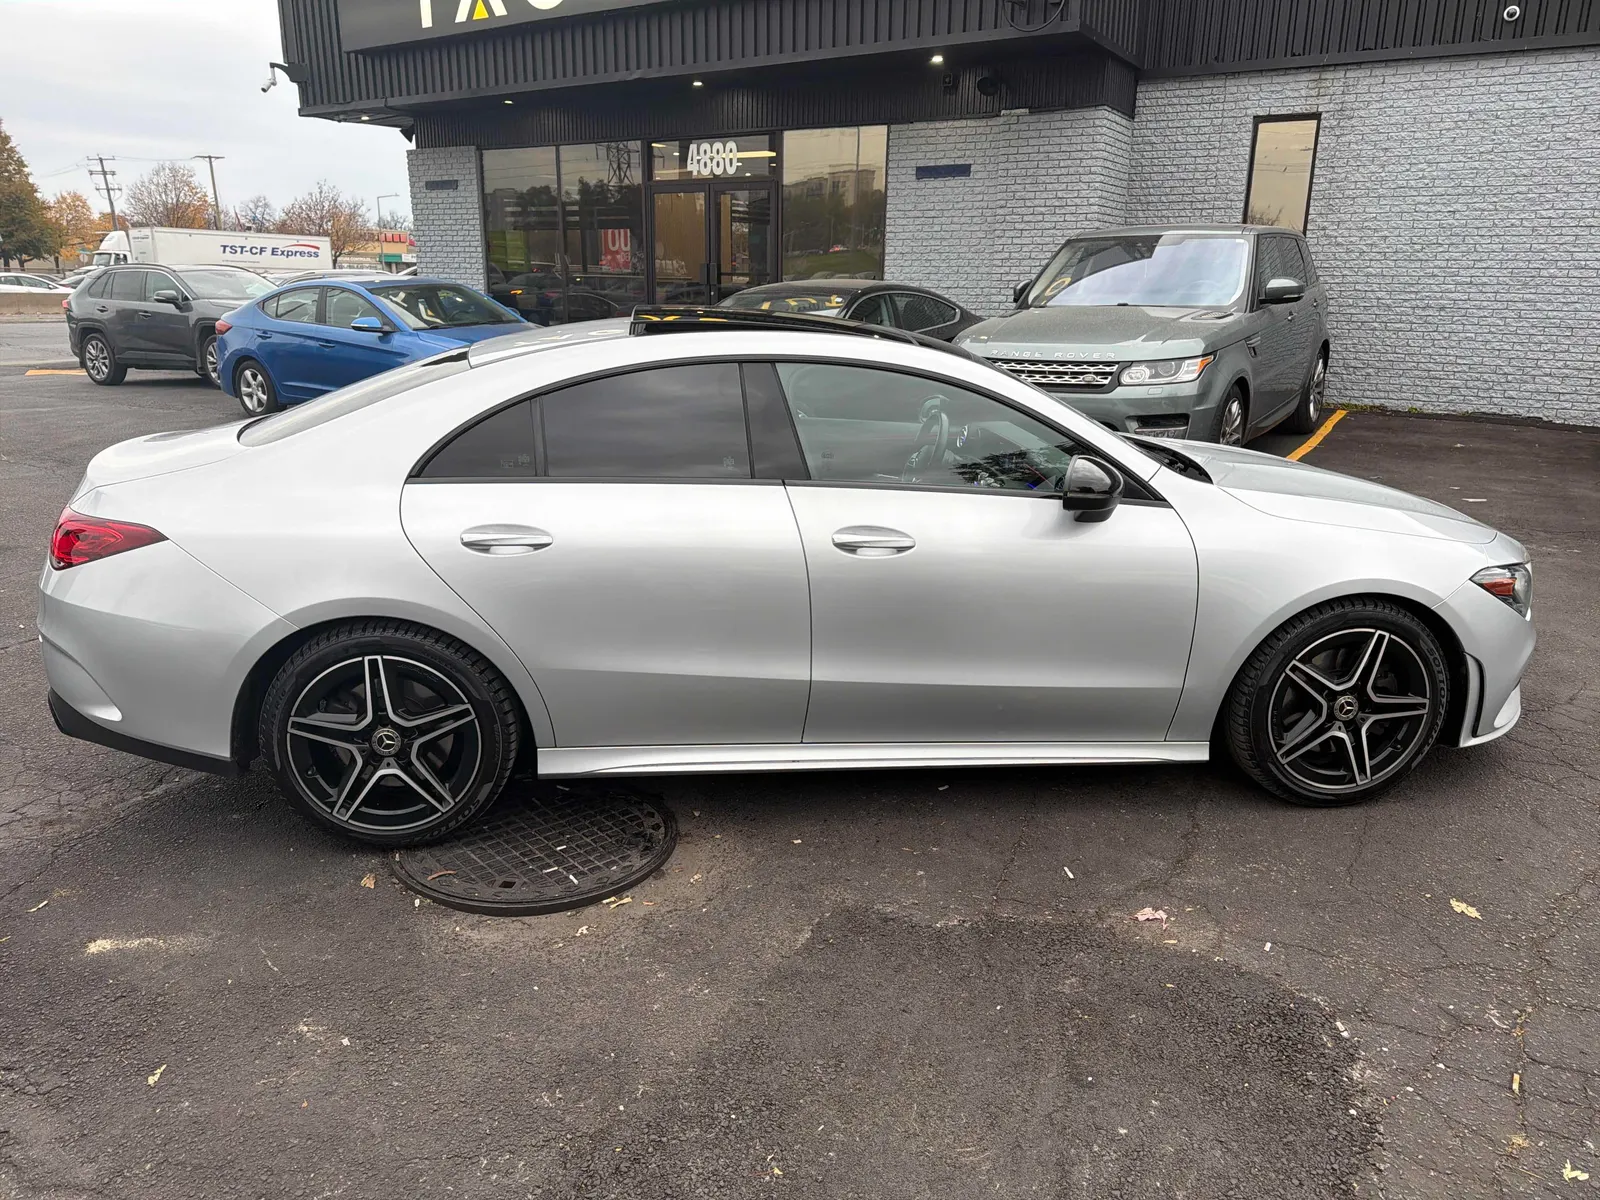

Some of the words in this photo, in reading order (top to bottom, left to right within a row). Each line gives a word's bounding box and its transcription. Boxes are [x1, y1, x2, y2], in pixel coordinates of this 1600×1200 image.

[687, 140, 738, 176] 4880
[220, 244, 267, 256] TST-CF
[271, 246, 320, 259] Express
[990, 348, 1043, 359] RANGE
[1054, 351, 1117, 360] ROVER
